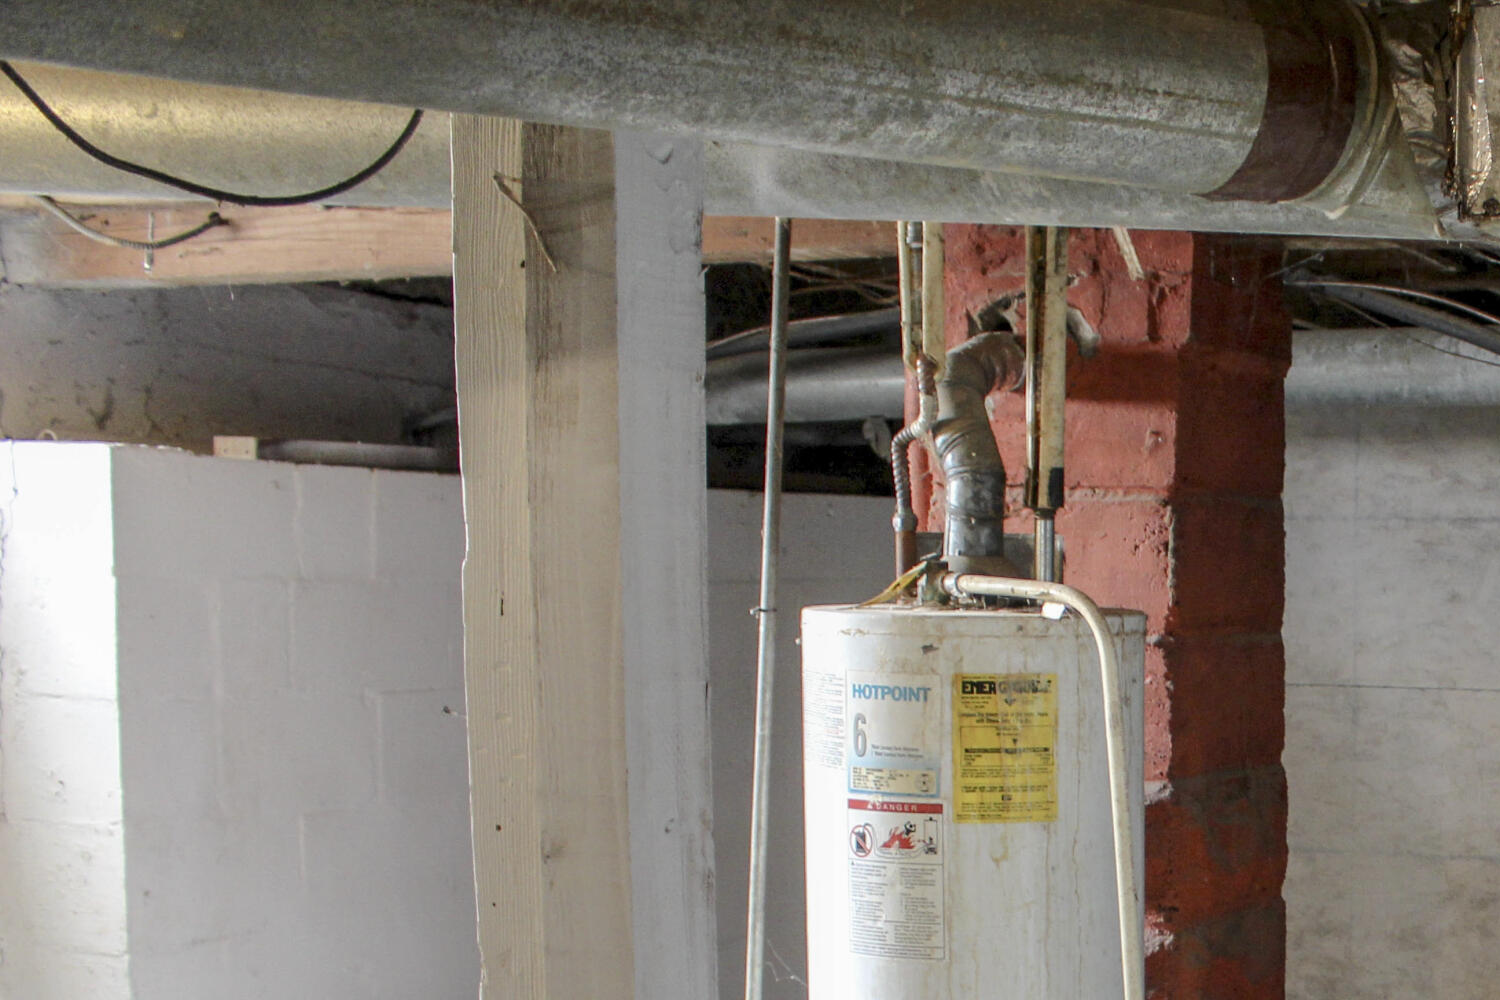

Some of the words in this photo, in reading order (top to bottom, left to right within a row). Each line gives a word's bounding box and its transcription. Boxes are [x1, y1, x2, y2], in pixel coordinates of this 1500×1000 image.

[852, 683, 931, 703] HOTPOINT
[853, 713, 867, 758] 6
[876, 803, 918, 812] DANGER
